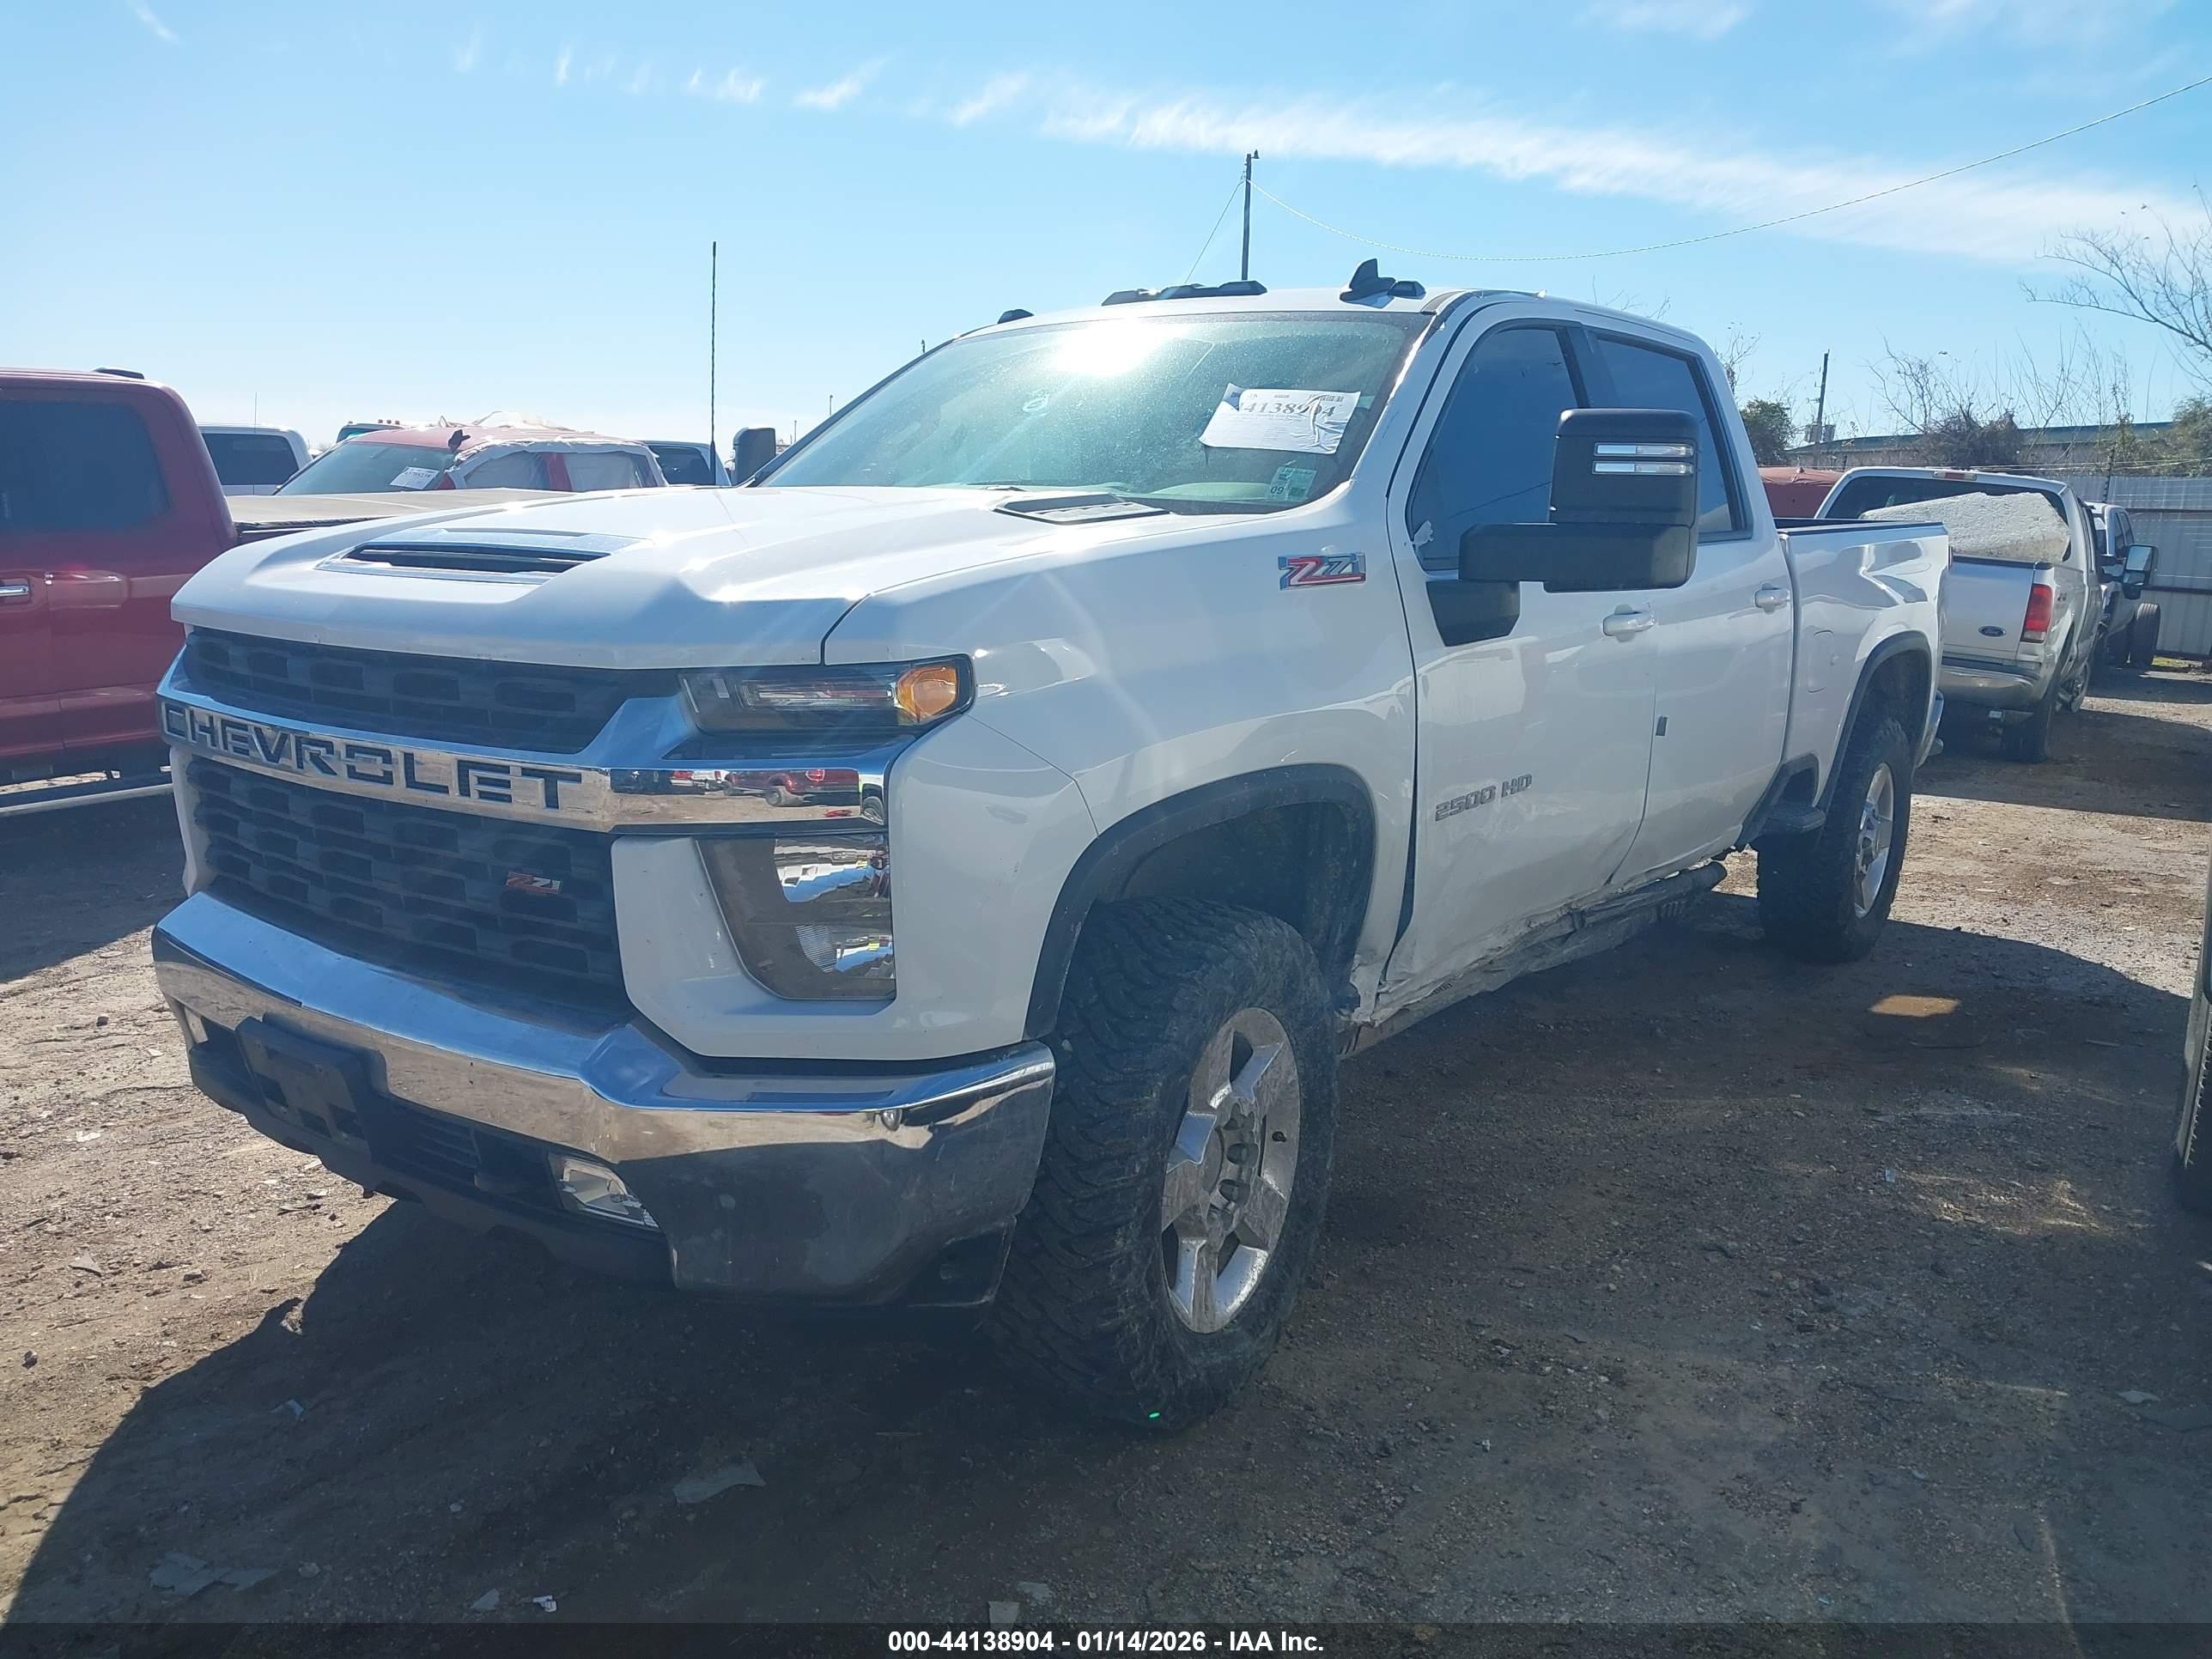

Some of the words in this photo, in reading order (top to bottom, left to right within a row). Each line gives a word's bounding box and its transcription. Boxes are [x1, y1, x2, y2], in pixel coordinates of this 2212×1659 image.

[1270, 485, 1285, 495] 09
[1278, 552, 1366, 591] Z71
[161, 704, 582, 810] CHEVROLET
[1435, 785, 1497, 822] 2500
[1501, 774, 1533, 798] HD
